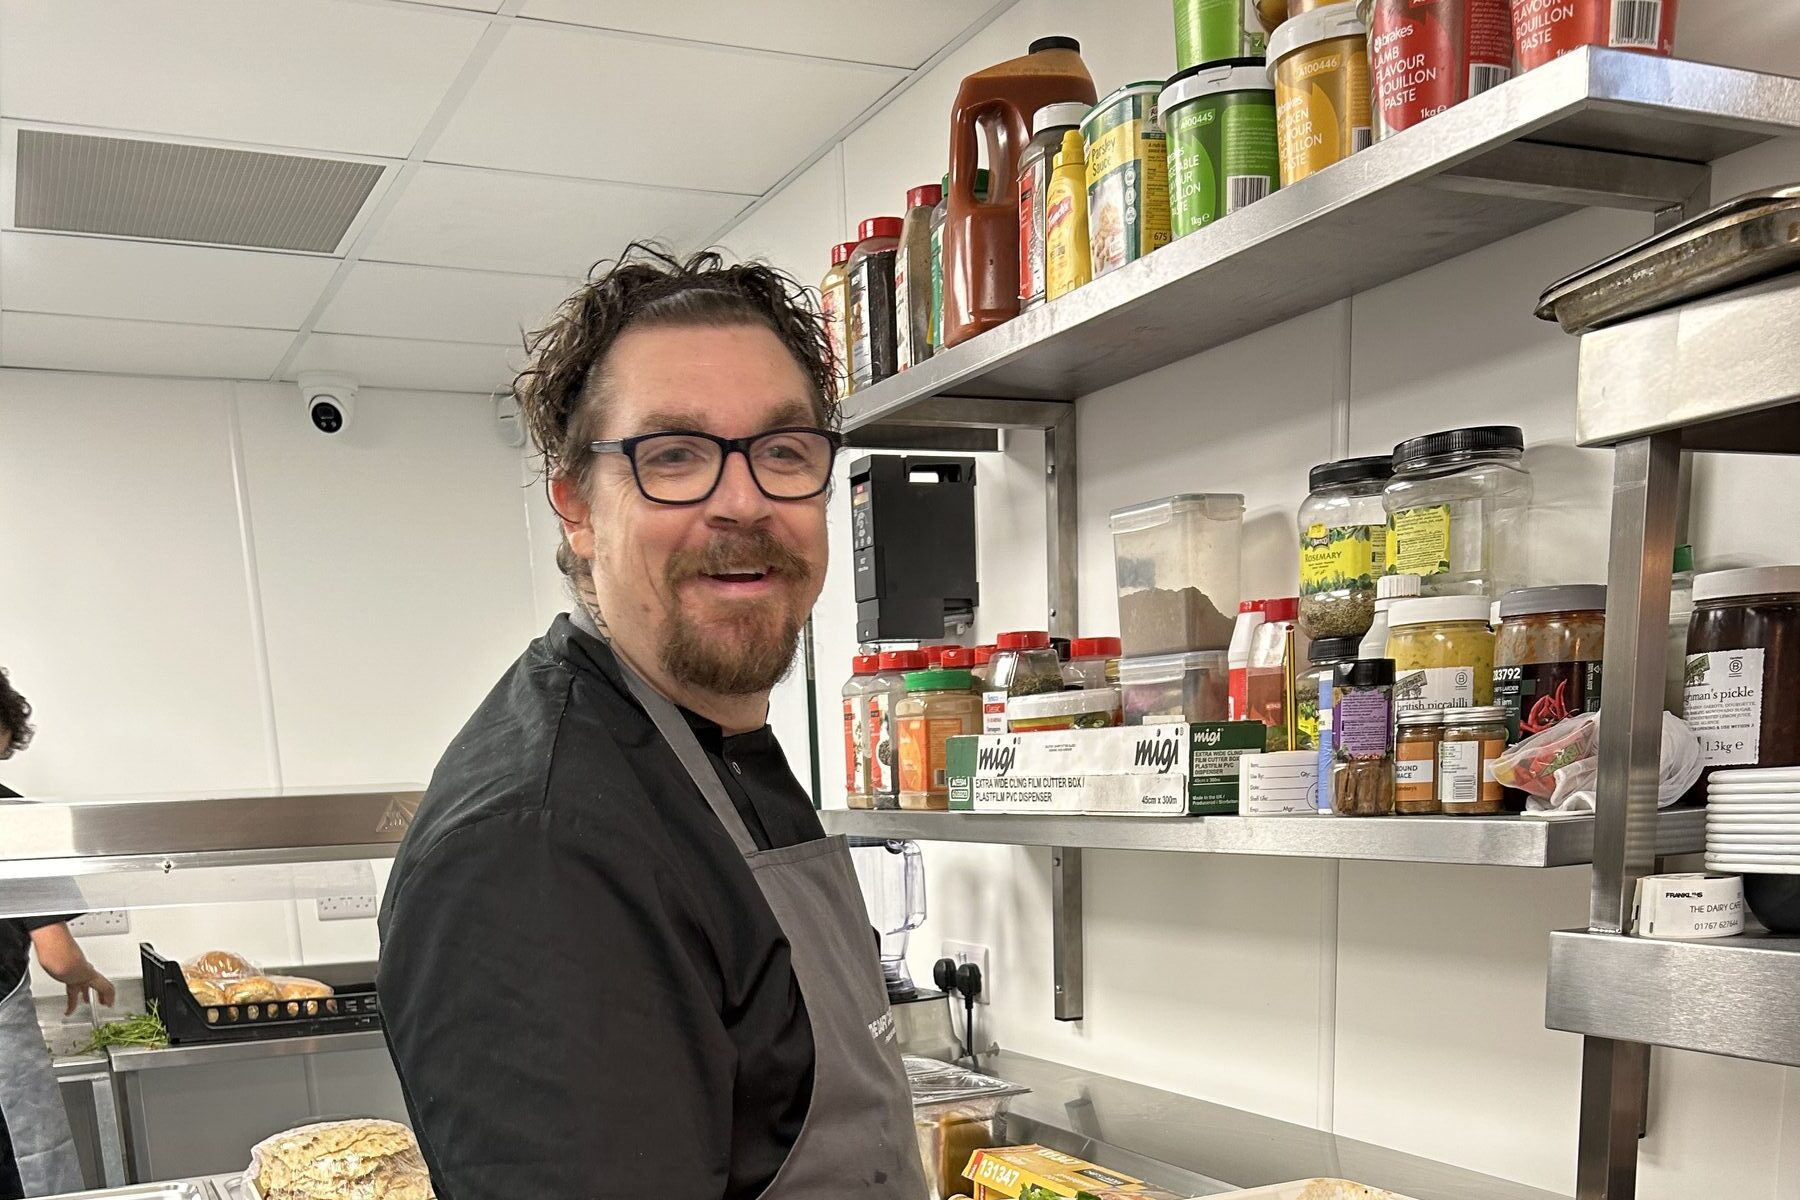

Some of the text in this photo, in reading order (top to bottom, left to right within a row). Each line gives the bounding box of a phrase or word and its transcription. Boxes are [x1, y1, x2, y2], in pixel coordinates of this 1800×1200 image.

[1514, 0, 1561, 25] FLAVOU
[1516, 4, 1574, 41] BOUILLON
[1382, 24, 1414, 46] brakes
[1521, 28, 1552, 54] PASTE
[1299, 57, 1337, 77] A100446
[1374, 46, 1400, 70] LAMB
[1376, 54, 1425, 84] FLAVOUR
[1379, 67, 1436, 98] BOUILLON
[1384, 88, 1416, 111] PASTE
[1091, 136, 1117, 159] Parsley
[1153, 231, 1168, 241] 675
[1304, 551, 1342, 563] ROSEMARY
[1428, 698, 1468, 710] piccalilli
[1720, 686, 1754, 702] pickle
[1194, 728, 1221, 746] migi
[1705, 740, 1733, 754] 1.3kg
[978, 737, 1017, 777] migi
[1134, 727, 1180, 775] migi
[976, 777, 993, 789] EXTRA
[994, 777, 1009, 789] WIDE
[1009, 777, 1028, 788] CLING
[1028, 777, 1042, 788] FILM
[1043, 777, 1067, 788] CUTTER
[1068, 776, 1082, 788] BOX
[976, 791, 1053, 802] PLASTFILM PVC DISPENSER
[1142, 796, 1157, 805] 45cm
[1162, 795, 1178, 805] 300m
[1690, 905, 1705, 913] THE
[1706, 903, 1728, 913] DAIRY
[1694, 922, 1717, 931] 01767
[979, 1158, 1021, 1188] 131347
